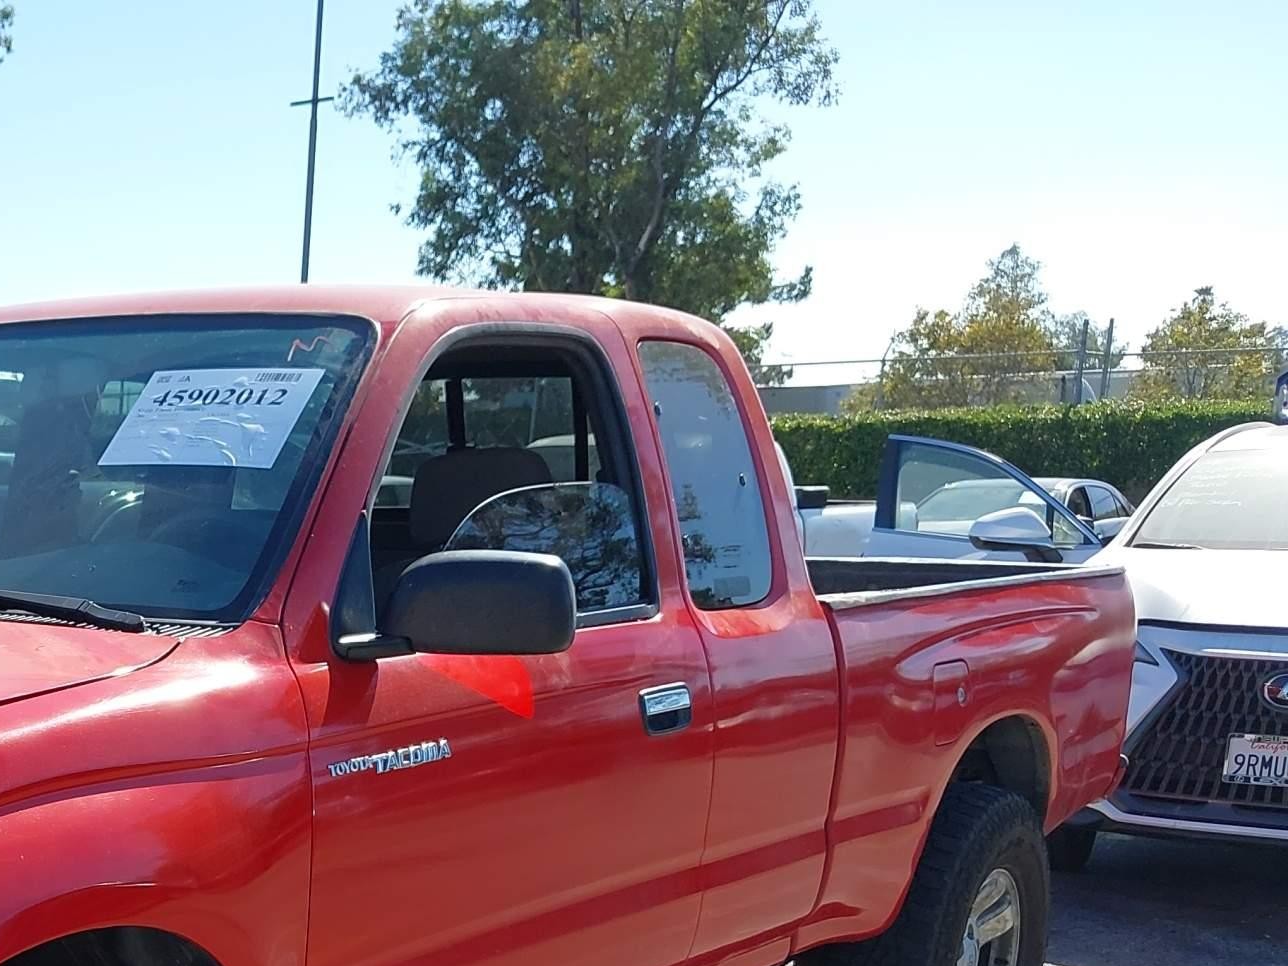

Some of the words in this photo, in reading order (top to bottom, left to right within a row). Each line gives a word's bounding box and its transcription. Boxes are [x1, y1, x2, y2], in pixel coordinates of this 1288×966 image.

[153, 388, 288, 407] 45902012
[374, 737, 452, 774] TACOMA
[1245, 738, 1288, 754] Califo
[1233, 753, 1288, 778] 9RMU
